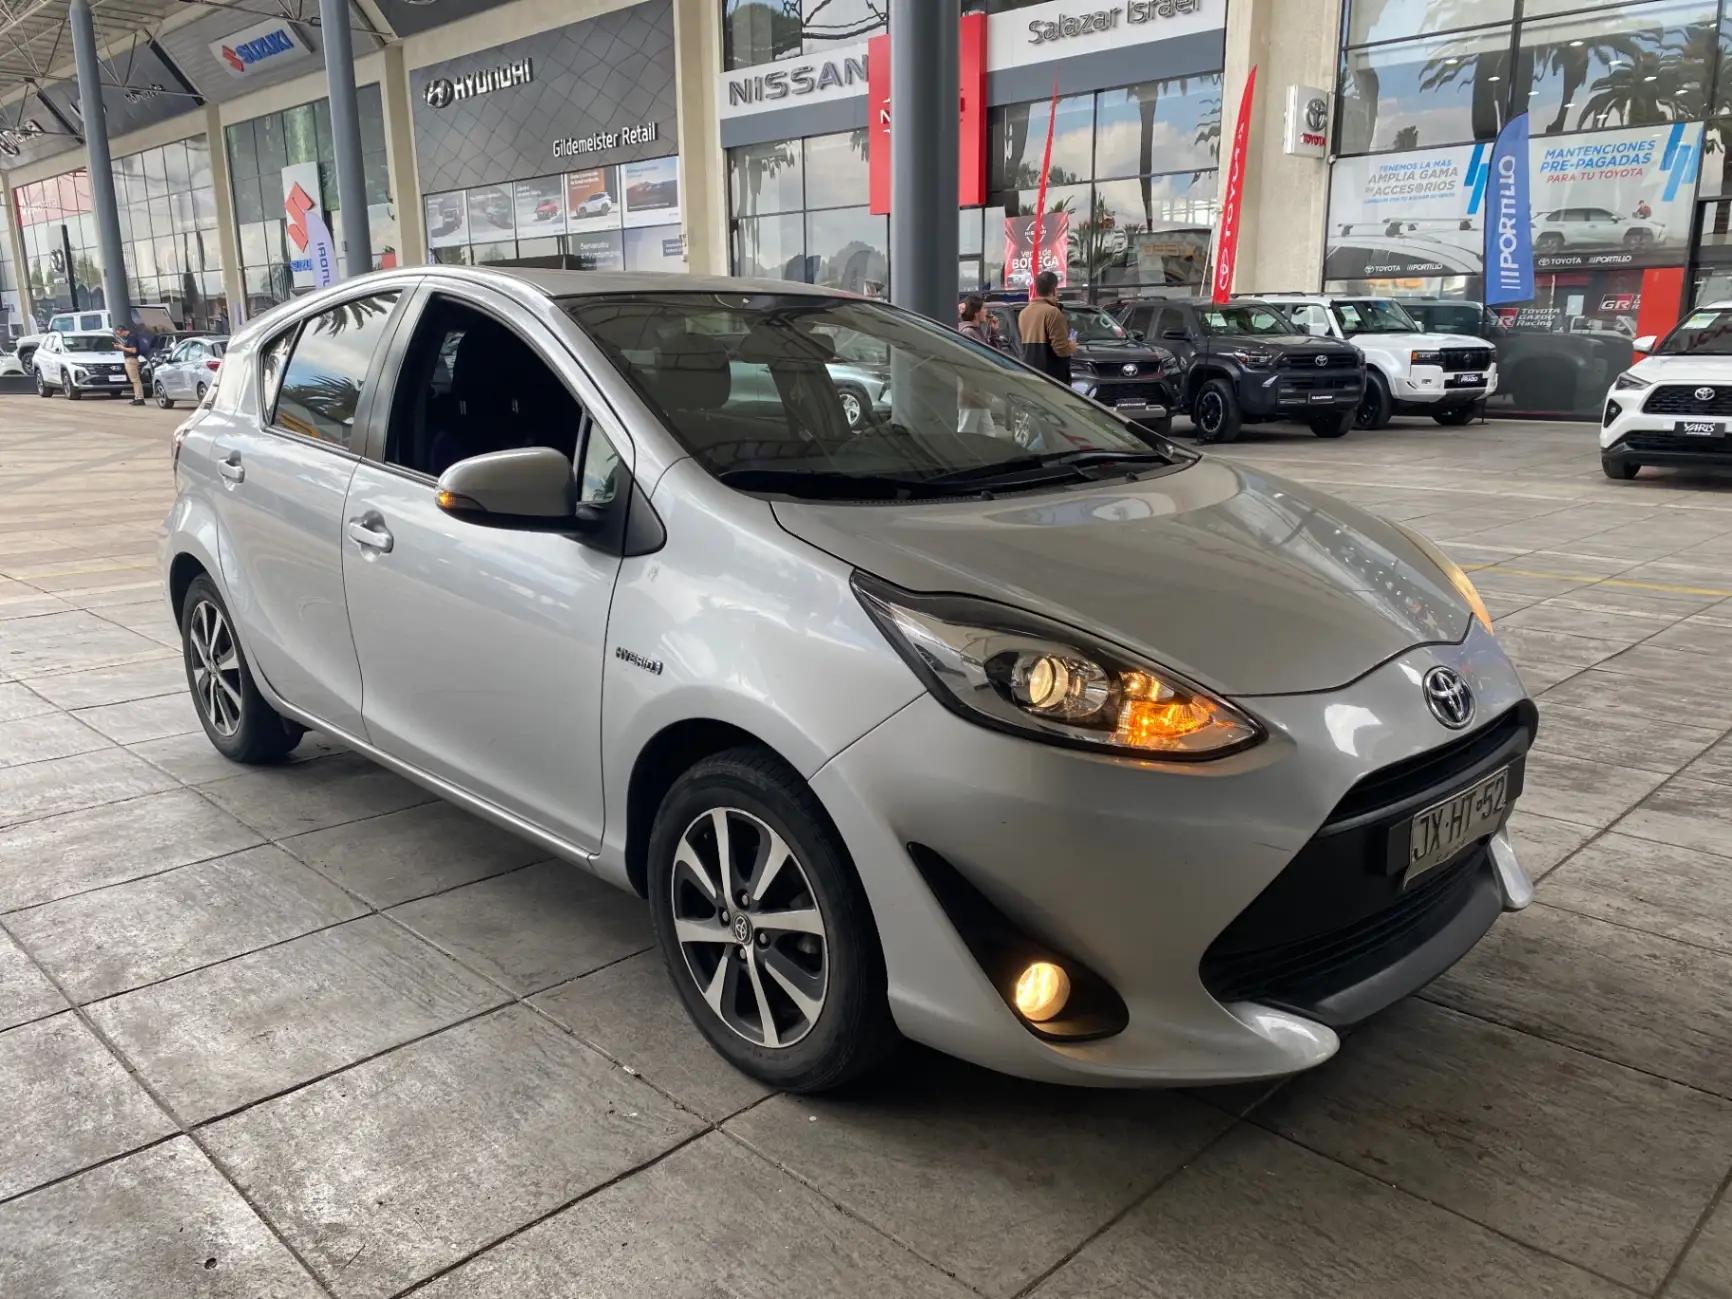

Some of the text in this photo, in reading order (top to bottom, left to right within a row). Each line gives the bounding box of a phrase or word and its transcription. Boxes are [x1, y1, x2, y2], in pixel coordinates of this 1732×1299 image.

[1028, 7, 1121, 44] Salazar
[236, 29, 294, 64] SUZUKI
[452, 58, 532, 100] HYUNDAI
[729, 54, 868, 106] NISSAN
[553, 122, 656, 157] Gildemeister Retail
[1300, 133, 1326, 146] TOYOTA
[1545, 140, 1656, 160] MANTENCIONES
[1380, 163, 1417, 173] TENEMOS
[1420, 161, 1431, 169] LA
[1540, 153, 1653, 173] PRE-PAGADAS
[1368, 167, 1458, 185] AMPLIA GAMA
[1546, 168, 1643, 184] PARA TU TOYOTA
[1499, 155, 1519, 268] PORTILLO
[1551, 257, 1581, 265] TOYOTA
[1601, 300, 1631, 310] GR
[1684, 422, 1716, 432] YARIS
